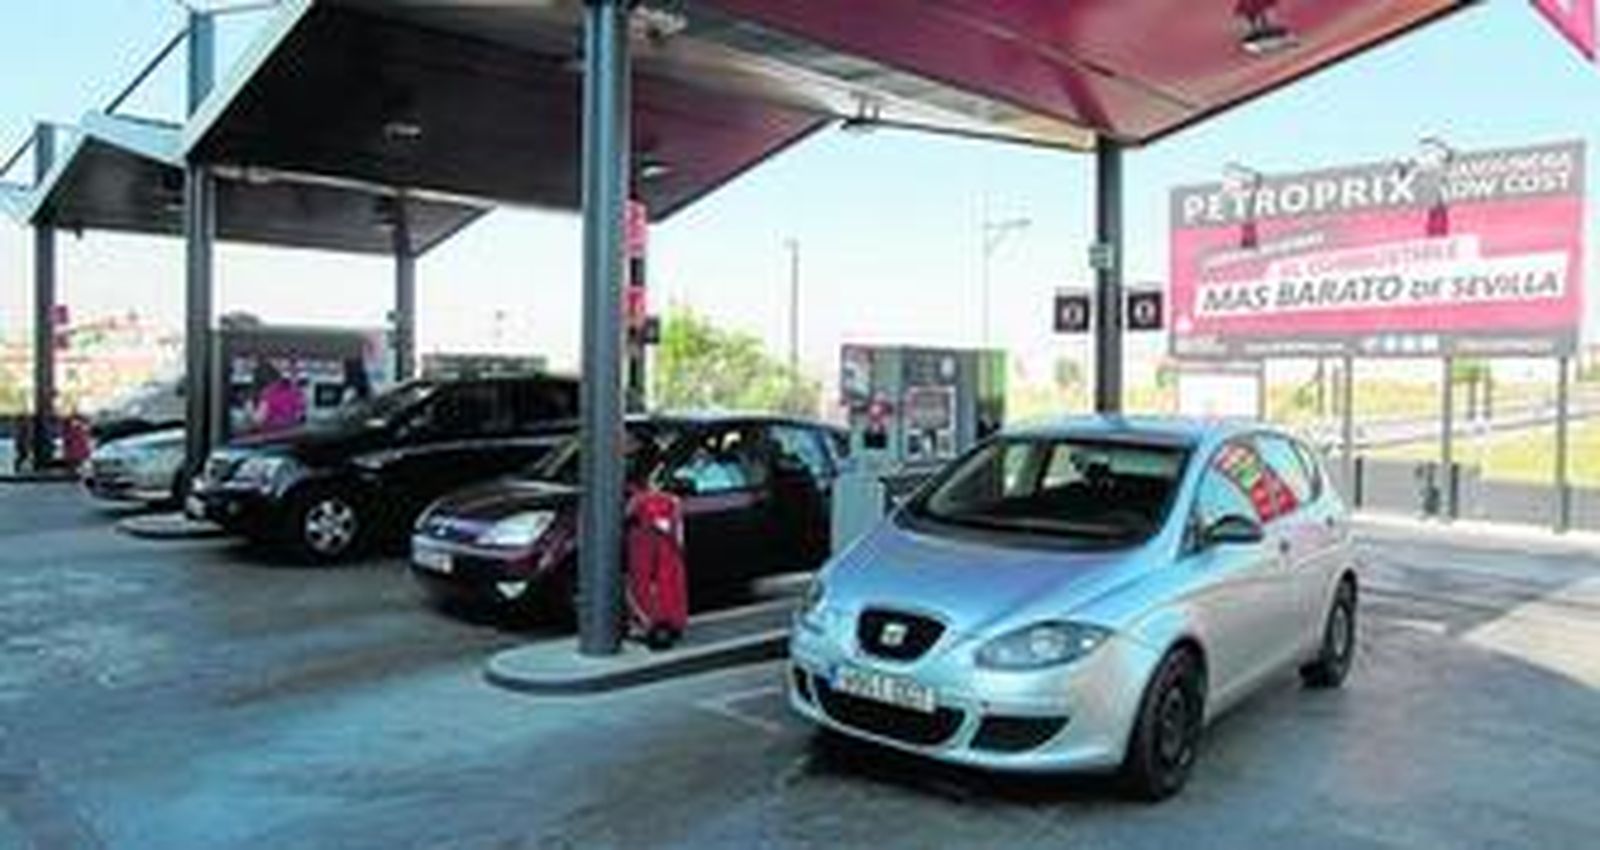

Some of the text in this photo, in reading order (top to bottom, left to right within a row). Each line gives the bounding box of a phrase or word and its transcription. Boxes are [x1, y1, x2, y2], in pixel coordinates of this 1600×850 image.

[1184, 168, 1417, 223] PETROPRIX
[1504, 170, 1568, 193] COST
[1275, 274, 1404, 305] BARATO
[1409, 278, 1445, 299] DE
[1450, 271, 1558, 298] SEVILLA
